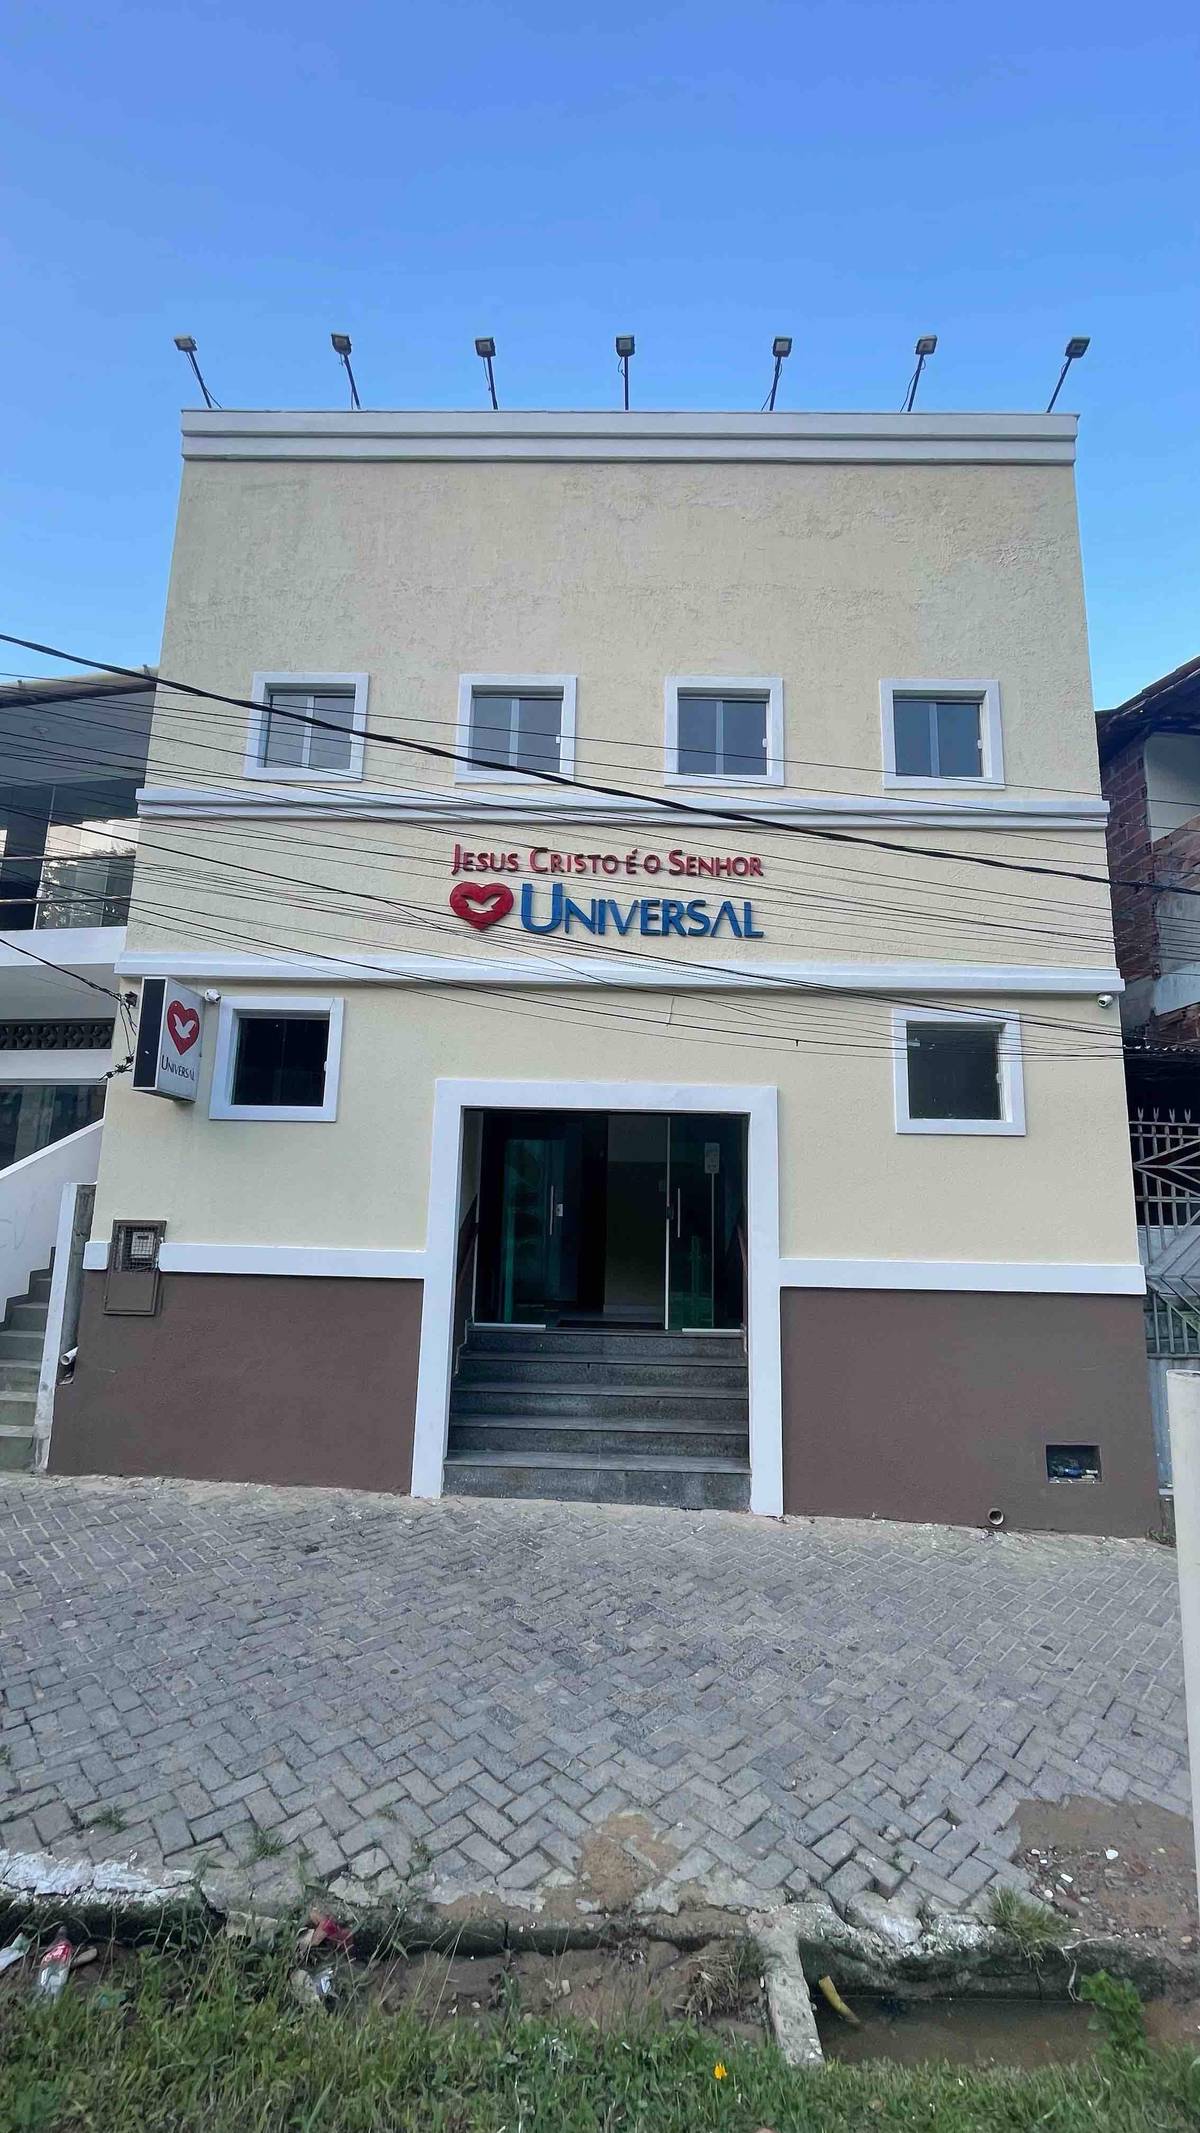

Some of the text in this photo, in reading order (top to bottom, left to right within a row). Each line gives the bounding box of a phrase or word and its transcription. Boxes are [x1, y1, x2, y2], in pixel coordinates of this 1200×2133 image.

[451, 844, 519, 876] JESUS
[529, 848, 619, 874] CRISTO
[643, 854, 661, 875] O
[668, 849, 764, 877] SENHOR
[521, 883, 764, 938] UNIVERSAL
